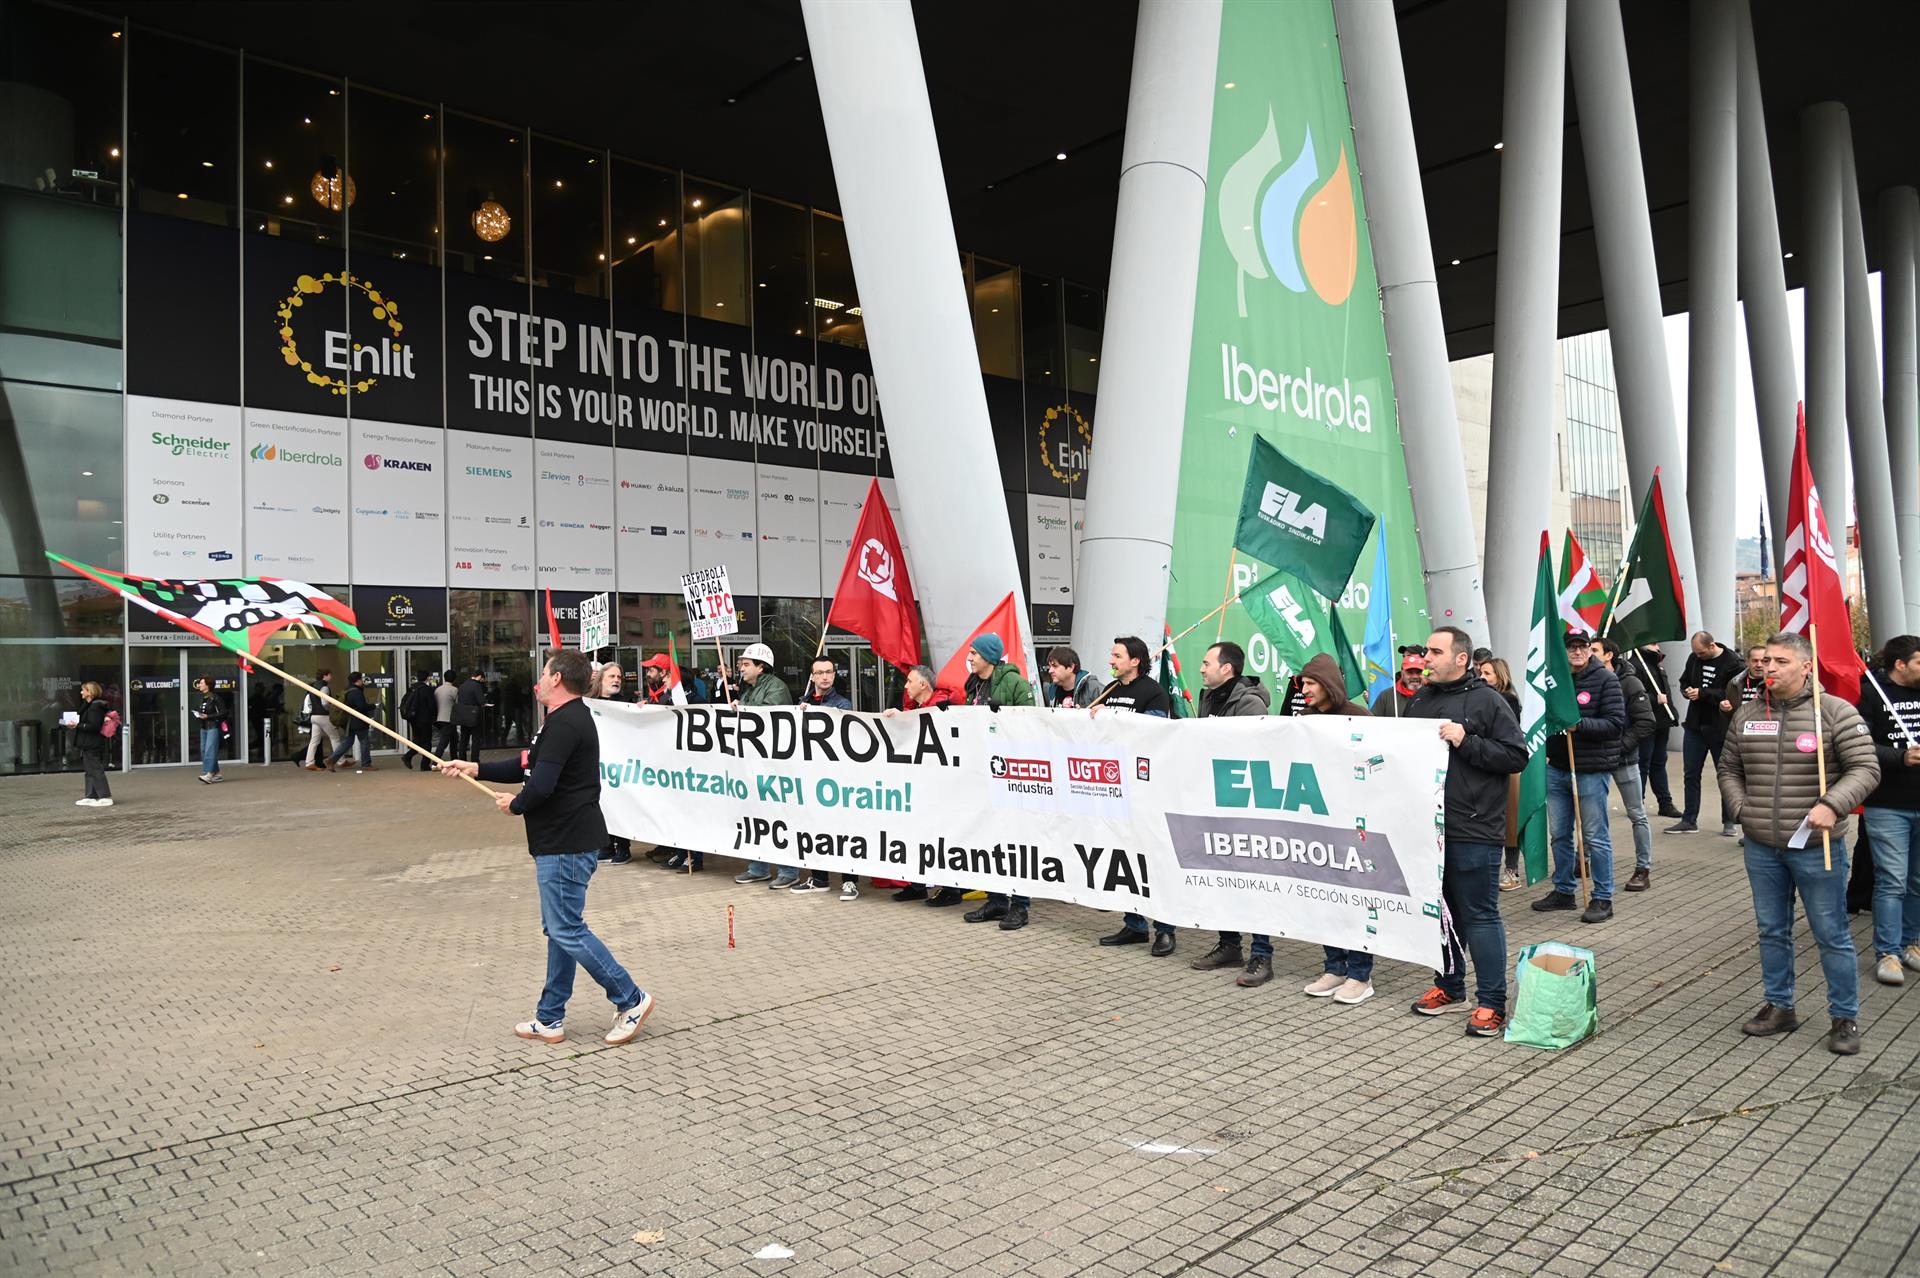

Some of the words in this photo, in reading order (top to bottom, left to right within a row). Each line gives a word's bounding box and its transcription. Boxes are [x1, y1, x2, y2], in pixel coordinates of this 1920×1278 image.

[325, 330, 416, 380] Enlit
[468, 305, 566, 368] STEP
[578, 324, 659, 384] INTO
[669, 339, 731, 395] THE
[740, 351, 843, 410] WORLD
[1221, 343, 1372, 433] Iberdrola
[152, 411, 185, 421] Diamond
[187, 414, 213, 423] Partner
[469, 373, 529, 416] THIS
[538, 383, 562, 419] IS
[568, 387, 633, 428] YOUR
[639, 397, 723, 440] WORLD.
[730, 409, 788, 447] MAKE
[793, 419, 886, 460] YOURSELF
[250, 421, 270, 429] Green
[272, 423, 317, 434] Electrification
[318, 428, 341, 436] Partner
[152, 432, 230, 450] Schneider
[362, 433, 384, 441] Energy
[385, 435, 413, 443] Transition
[186, 448, 230, 459] Electric
[279, 449, 342, 466] Iberdrola
[492, 445, 511, 453] Partner
[1058, 442, 1087, 470] Enl
[384, 459, 432, 472] KRAKEN
[465, 466, 512, 478] SIEMENS
[153, 478, 185, 487] Sponsors
[1260, 480, 1328, 539] ELA
[1037, 515, 1067, 527] Schneider
[1257, 511, 1285, 530] EUSKADIKO
[153, 531, 175, 540] Utility
[176, 533, 206, 541] Partners
[1288, 527, 1321, 545] SINDIKATOA
[682, 566, 726, 586] IBERDROLA
[688, 584, 700, 599] NO
[701, 579, 724, 597] PAGA
[395, 605, 414, 614] Enlit
[552, 607, 578, 619] WE'RE
[687, 598, 706, 622] NI
[706, 592, 733, 619] IPC
[586, 625, 601, 650] IPC
[672, 708, 961, 768] IBERDROLA:
[1008, 762, 1049, 779] CCOO
[1069, 760, 1101, 781] UGT
[600, 757, 748, 800] ngileontzako
[756, 774, 803, 806] KPI
[816, 778, 912, 813] Orain!
[1008, 780, 1053, 796] industria
[1109, 787, 1123, 798] FICA
[1212, 758, 1330, 817] ELA
[733, 816, 788, 851] ¡IPC
[797, 831, 867, 861] para
[880, 831, 907, 864] la
[919, 836, 1065, 883] plantilla
[1074, 843, 1151, 898] YA!
[1203, 832, 1365, 873] IBERDROLA
[1185, 875, 1214, 888] ATAL
[1216, 876, 1281, 893] SINDIKALA
[1296, 883, 1348, 905] SECCIÓN
[1352, 896, 1412, 915] SINDICAL
[1424, 903, 1439, 916] ELA
